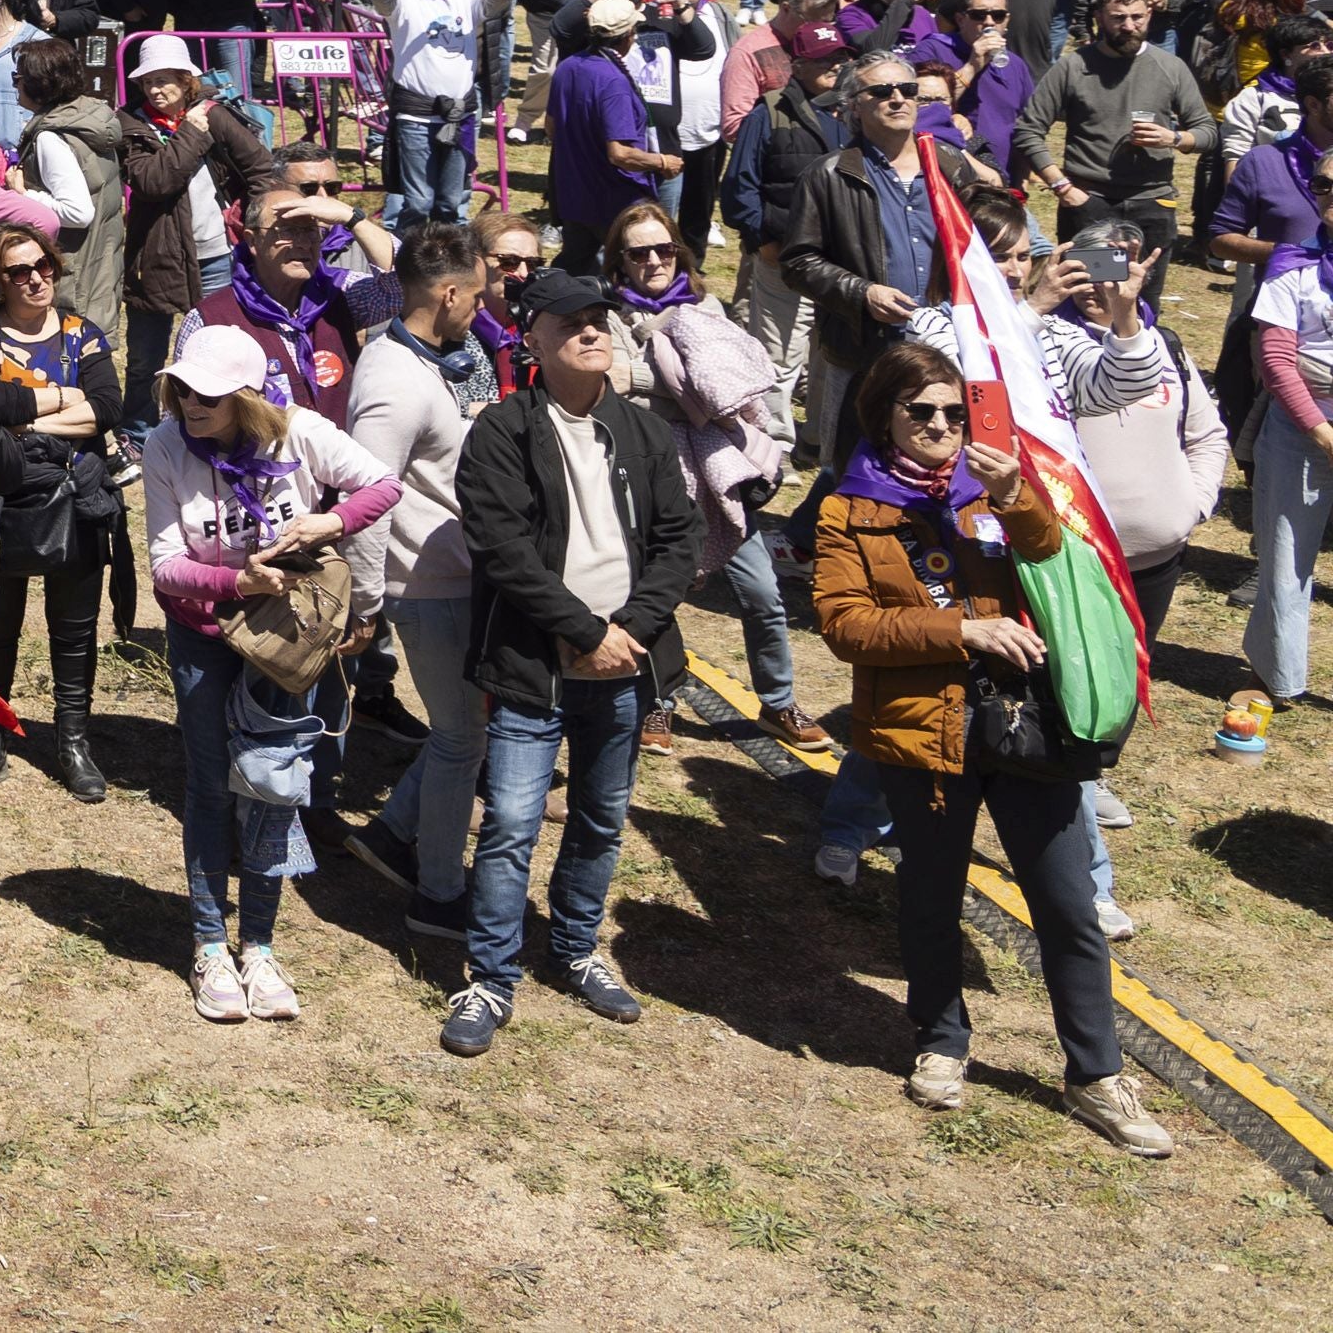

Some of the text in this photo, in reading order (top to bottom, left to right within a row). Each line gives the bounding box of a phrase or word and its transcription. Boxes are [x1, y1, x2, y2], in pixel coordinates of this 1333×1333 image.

[298, 45, 345, 59] alfe
[281, 62, 347, 71] 983 278 112
[93, 77, 101, 91] 1
[203, 502, 294, 539] PEACE
